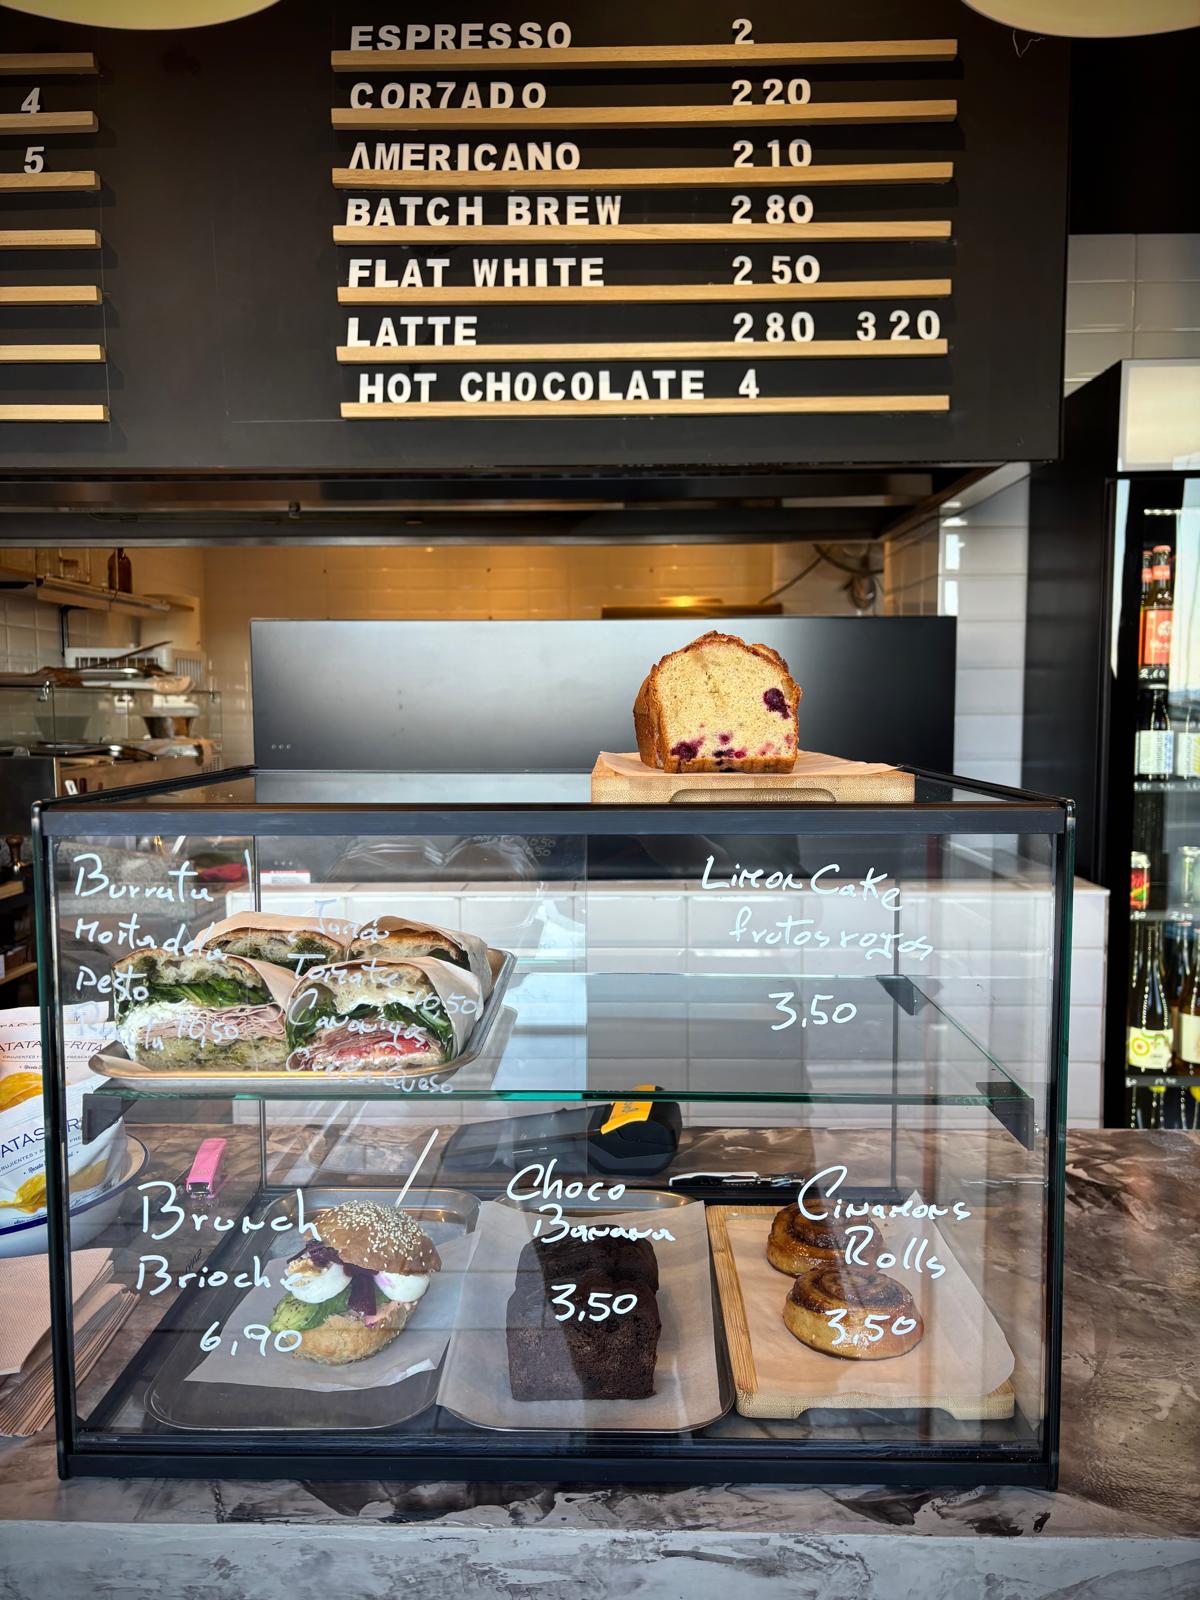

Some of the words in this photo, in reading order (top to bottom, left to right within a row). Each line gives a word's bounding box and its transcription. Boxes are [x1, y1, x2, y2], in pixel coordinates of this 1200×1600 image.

[350, 21, 572, 51] ESPRESSO
[731, 18, 754, 45] 2
[20, 87, 41, 114] 4
[23, 146, 46, 174] 5
[346, 196, 483, 226] BATCH
[507, 195, 622, 226] BREW
[348, 258, 450, 288] FLAT
[472, 257, 605, 288] WHITE
[346, 315, 478, 347] LATTE
[359, 373, 437, 404] HOT
[459, 369, 705, 403] CHOCOLATE
[738, 368, 760, 400] 4
[72, 852, 215, 903] Burrata
[810, 863, 904, 912] Cake
[75, 964, 150, 1001] Pesto
[768, 991, 858, 1031] 3,50
[506, 1158, 626, 1202] Choco
[137, 1180, 322, 1241] Brunch
[532, 1203, 676, 1244] Banana
[843, 1225, 946, 1280] Rolls
[551, 1283, 638, 1322] 3,50
[200, 1320, 303, 1357] 6,90
[824, 1308, 917, 1346] 3,50
